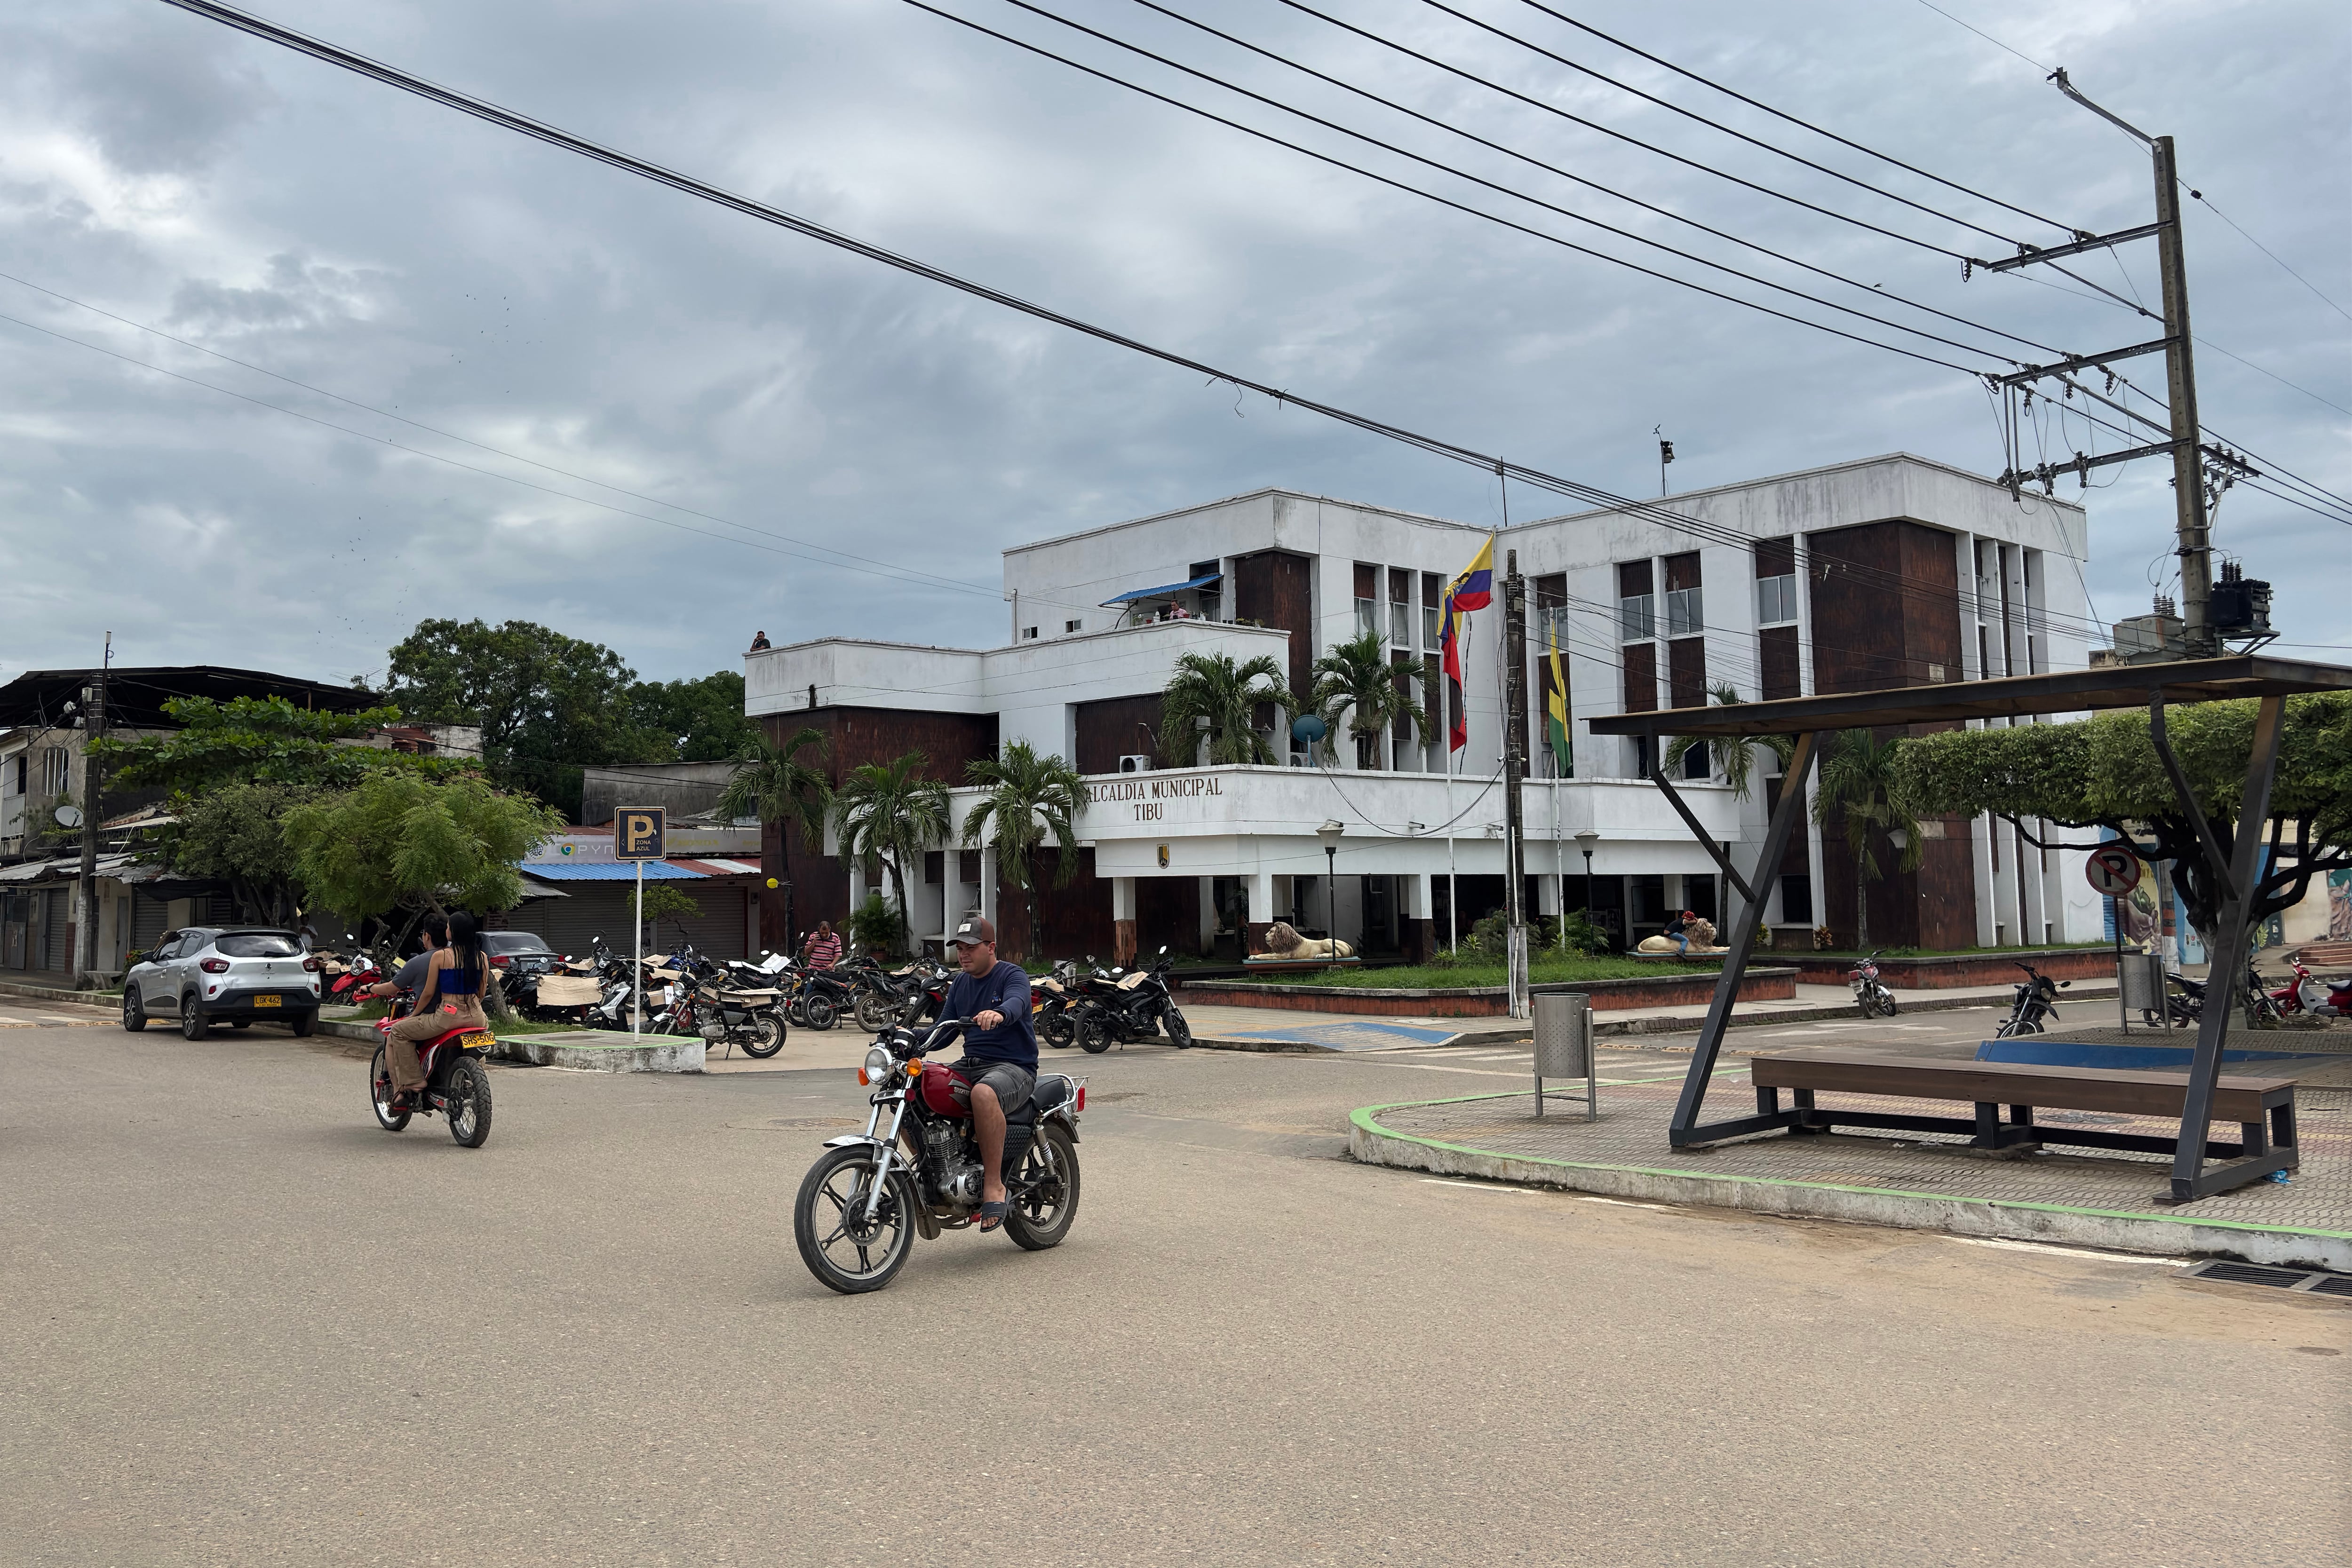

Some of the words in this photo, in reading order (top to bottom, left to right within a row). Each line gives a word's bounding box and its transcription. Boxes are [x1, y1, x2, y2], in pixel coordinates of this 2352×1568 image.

[1084, 783, 1145, 802] ALCALDIA
[1152, 778, 1223, 799] MUNICIPAL
[1134, 803, 1163, 821] TIBU
[628, 815, 654, 852] P
